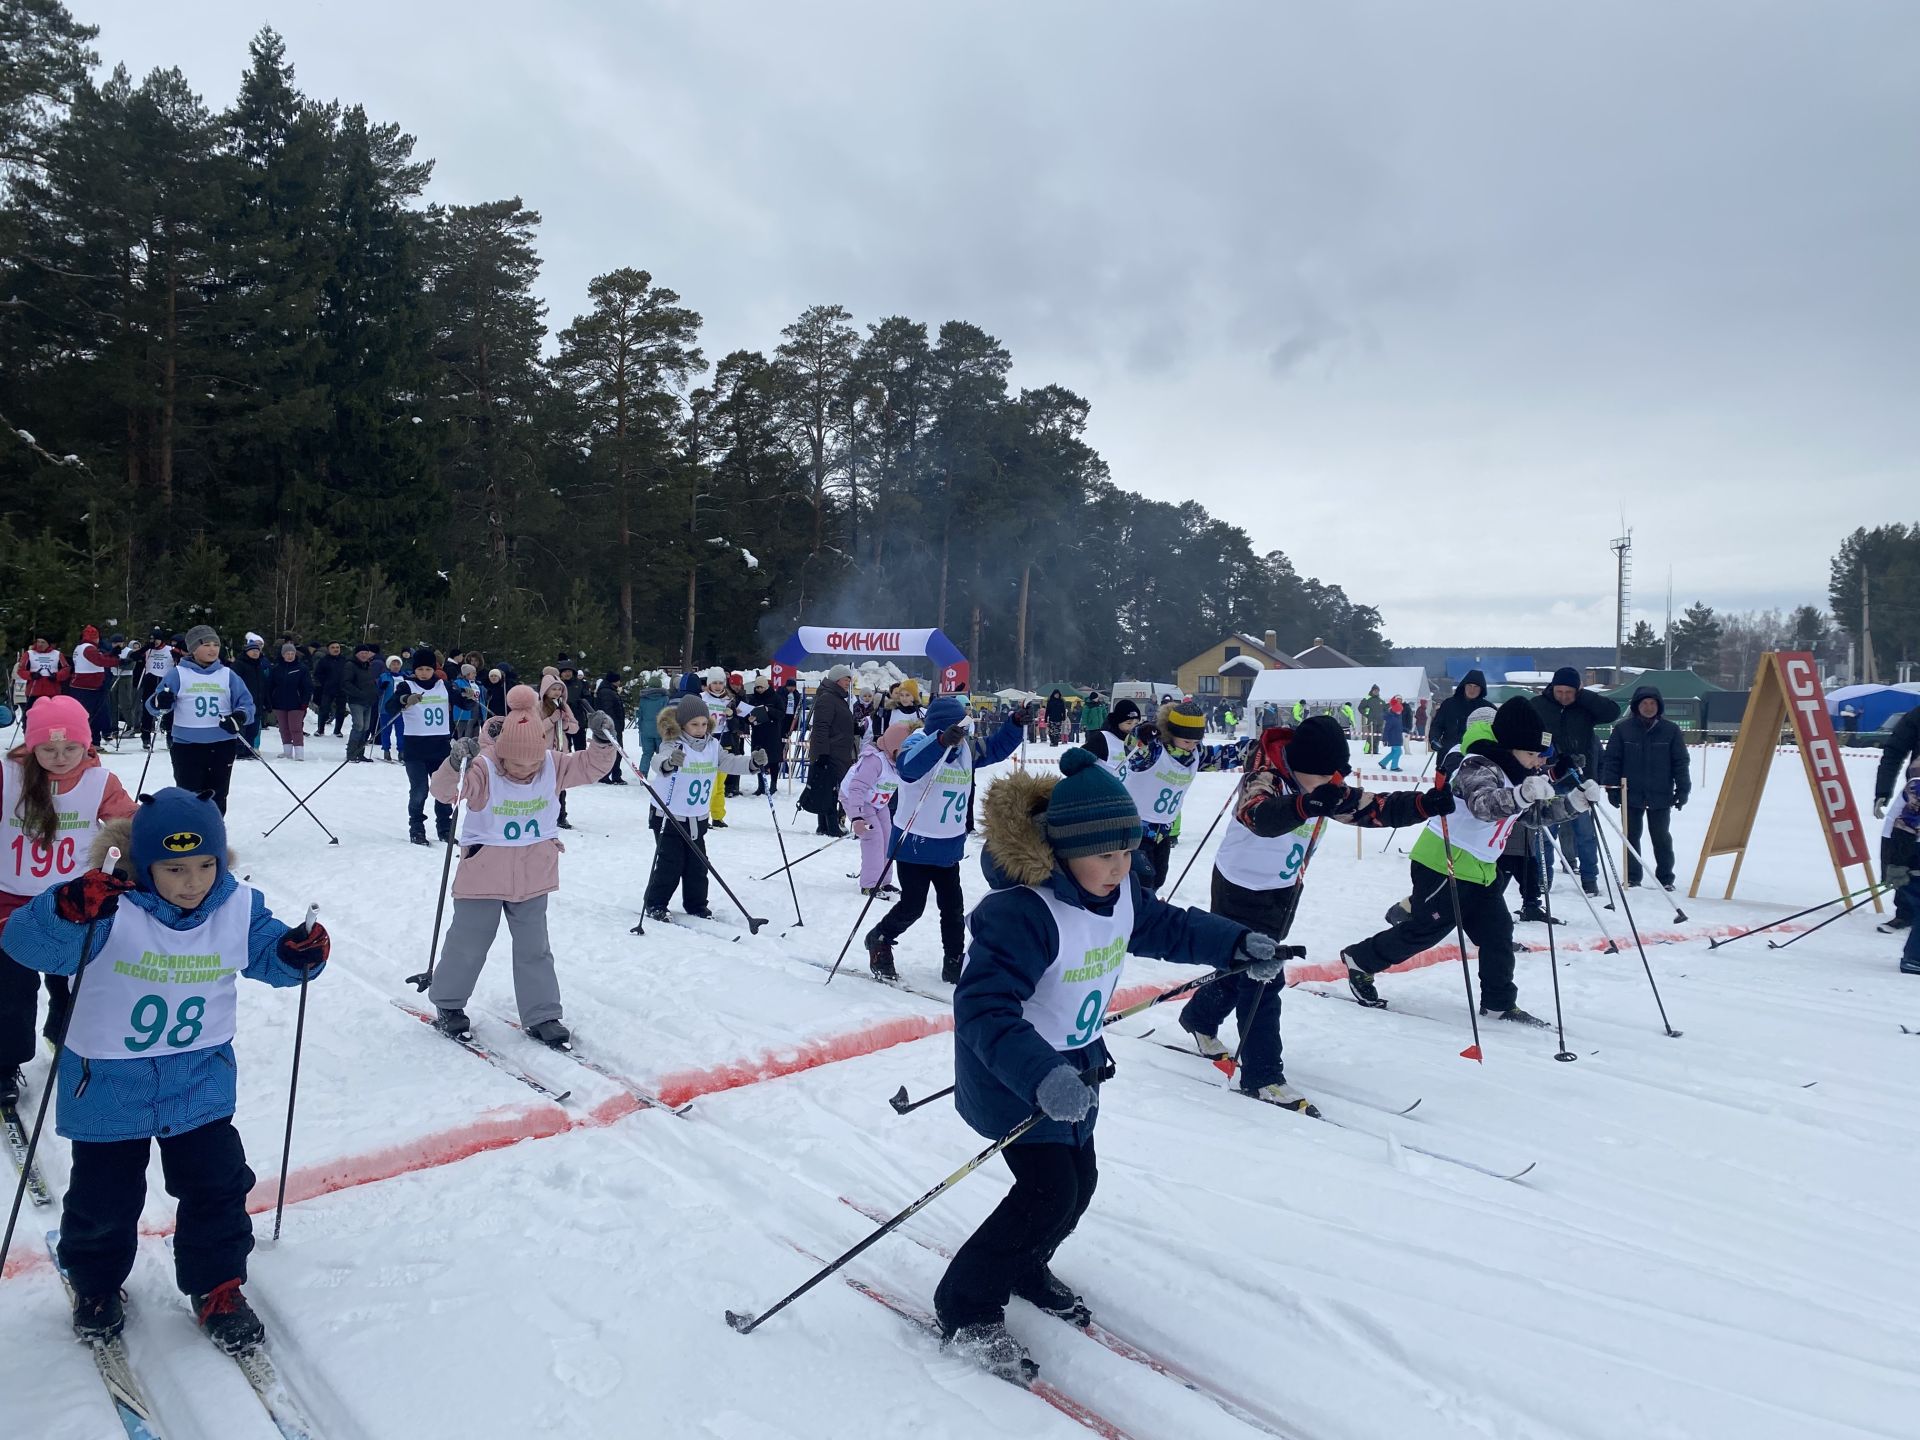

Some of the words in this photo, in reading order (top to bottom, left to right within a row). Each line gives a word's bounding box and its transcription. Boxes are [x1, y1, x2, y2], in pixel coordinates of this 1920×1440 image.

[826, 632, 900, 652] ФИНИШ
[194, 695, 220, 718] 95
[424, 707, 445, 726] 99
[1786, 659, 1858, 859] СТАРТ
[686, 778, 712, 806] 93
[940, 790, 966, 824] 79
[11, 834, 76, 878] 190
[140, 950, 222, 969] ЛУБЯНСКИЙ
[124, 994, 206, 1052] 98
